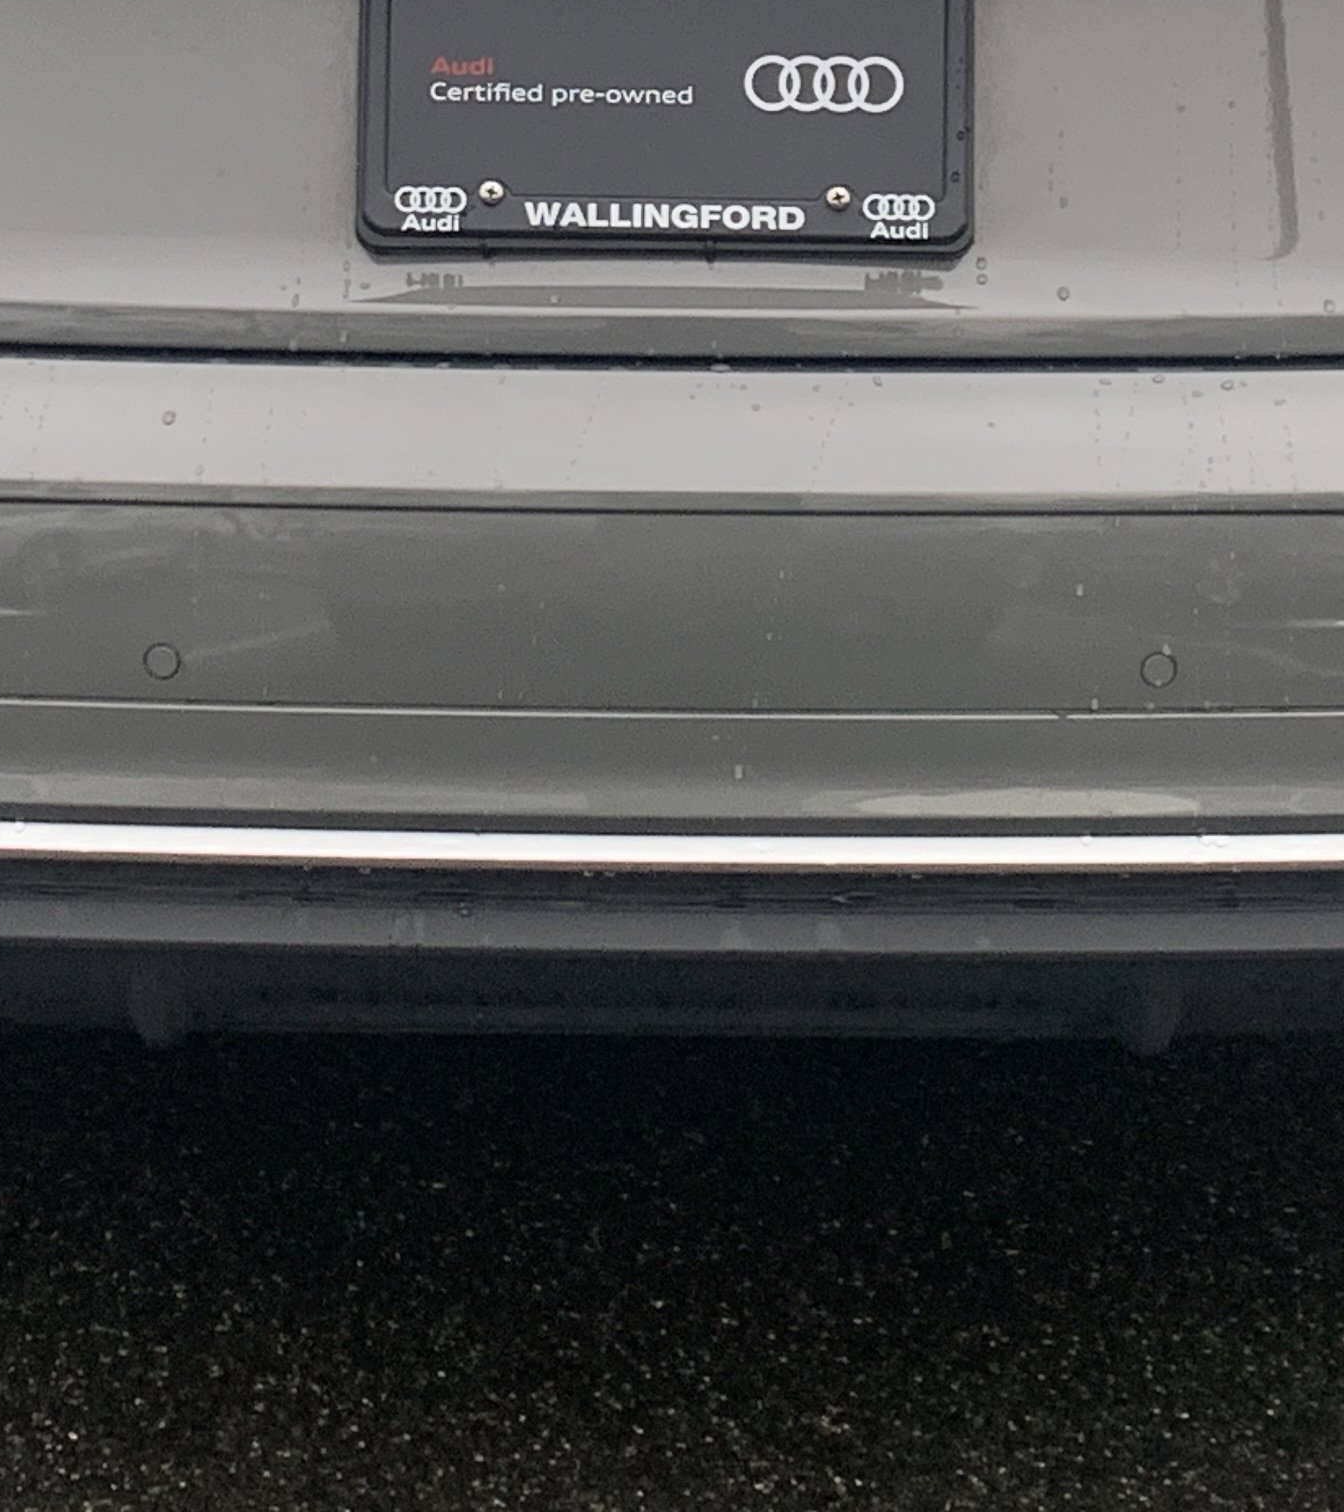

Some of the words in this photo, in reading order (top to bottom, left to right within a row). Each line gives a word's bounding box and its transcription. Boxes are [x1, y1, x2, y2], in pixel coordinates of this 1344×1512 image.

[430, 56, 494, 77] Audi
[430, 81, 544, 103] Certified
[551, 85, 694, 107] pre-owned
[400, 213, 461, 233] Audi
[523, 201, 806, 231] WALLINGFORD
[870, 221, 929, 241] Audi
